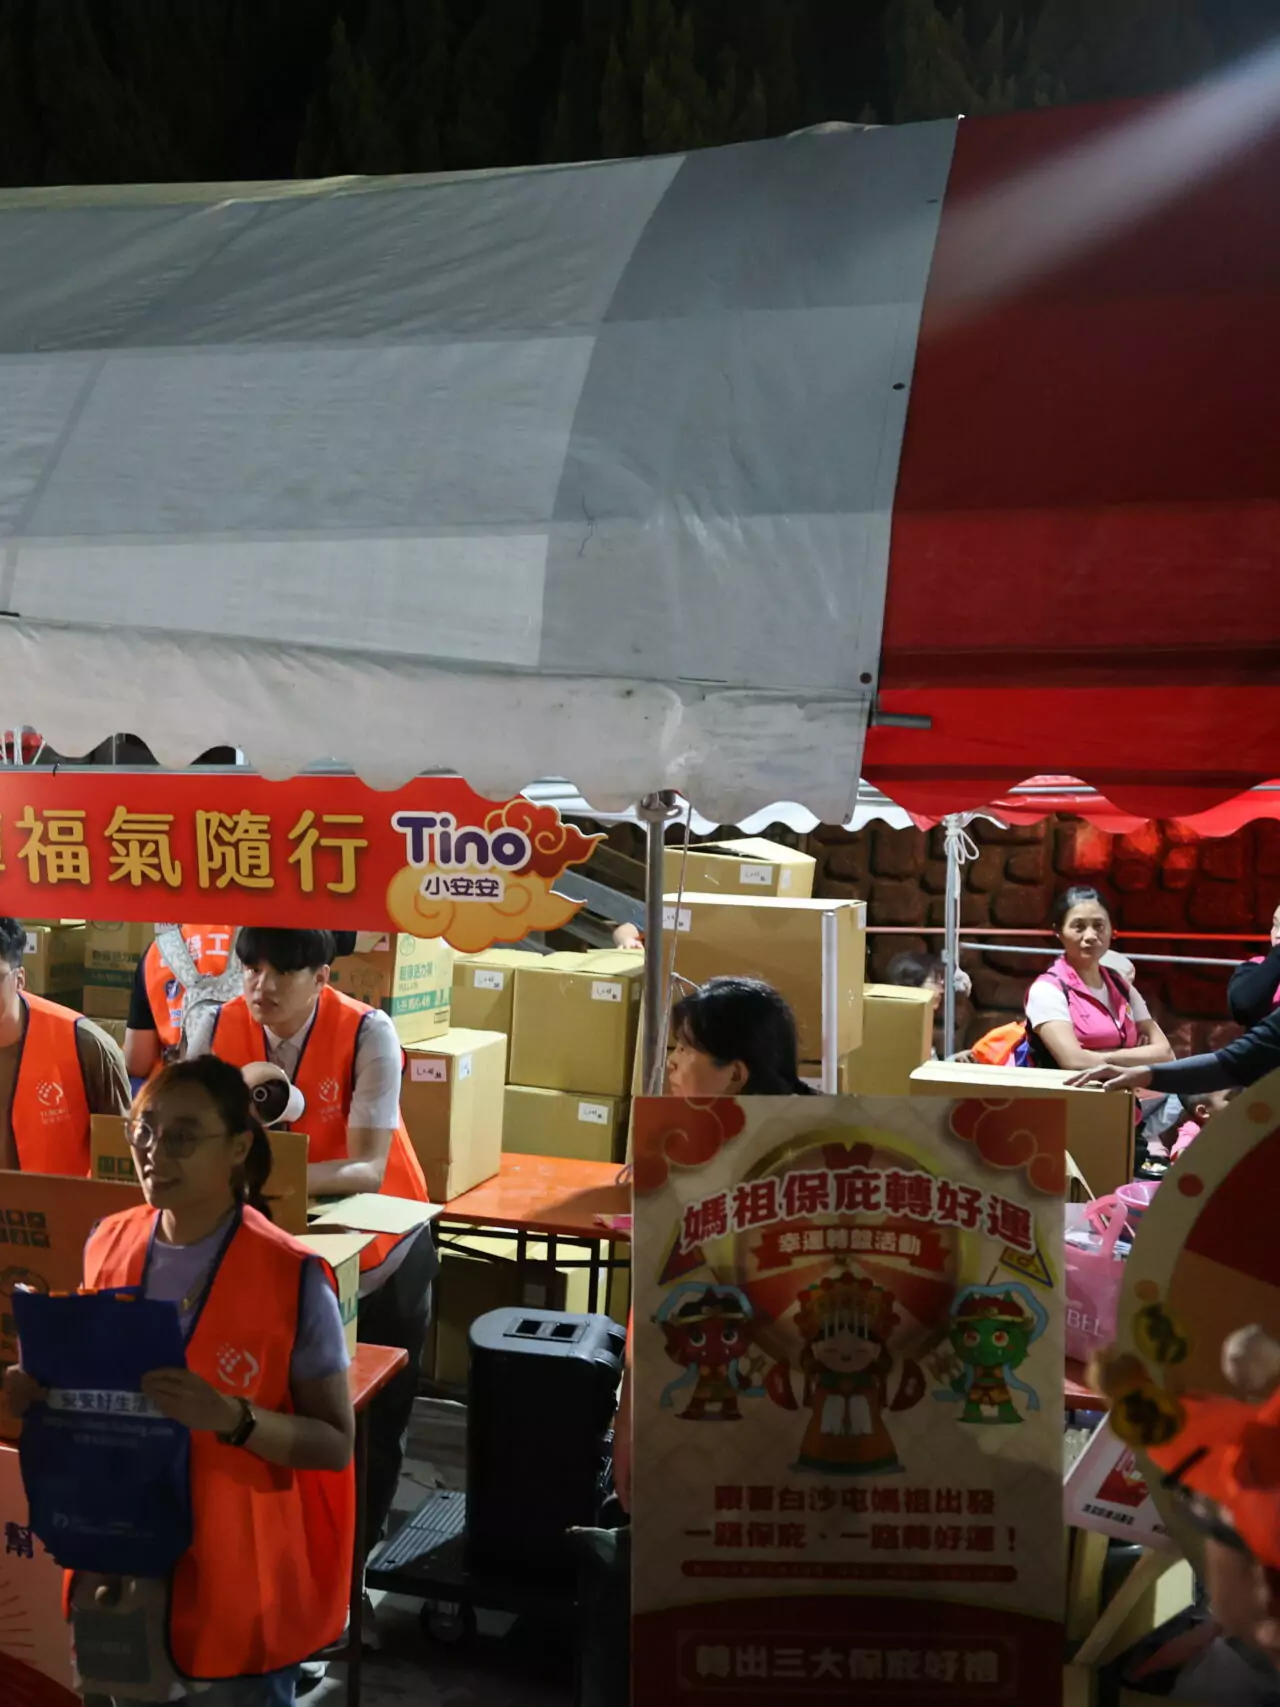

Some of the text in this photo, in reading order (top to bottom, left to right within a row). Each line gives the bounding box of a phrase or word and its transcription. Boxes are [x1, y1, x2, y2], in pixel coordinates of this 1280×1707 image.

[397, 817, 526, 865] Tino
[425, 877, 499, 897] 小安安
[682, 1171, 1032, 1249] 媽祖保庇轉好運
